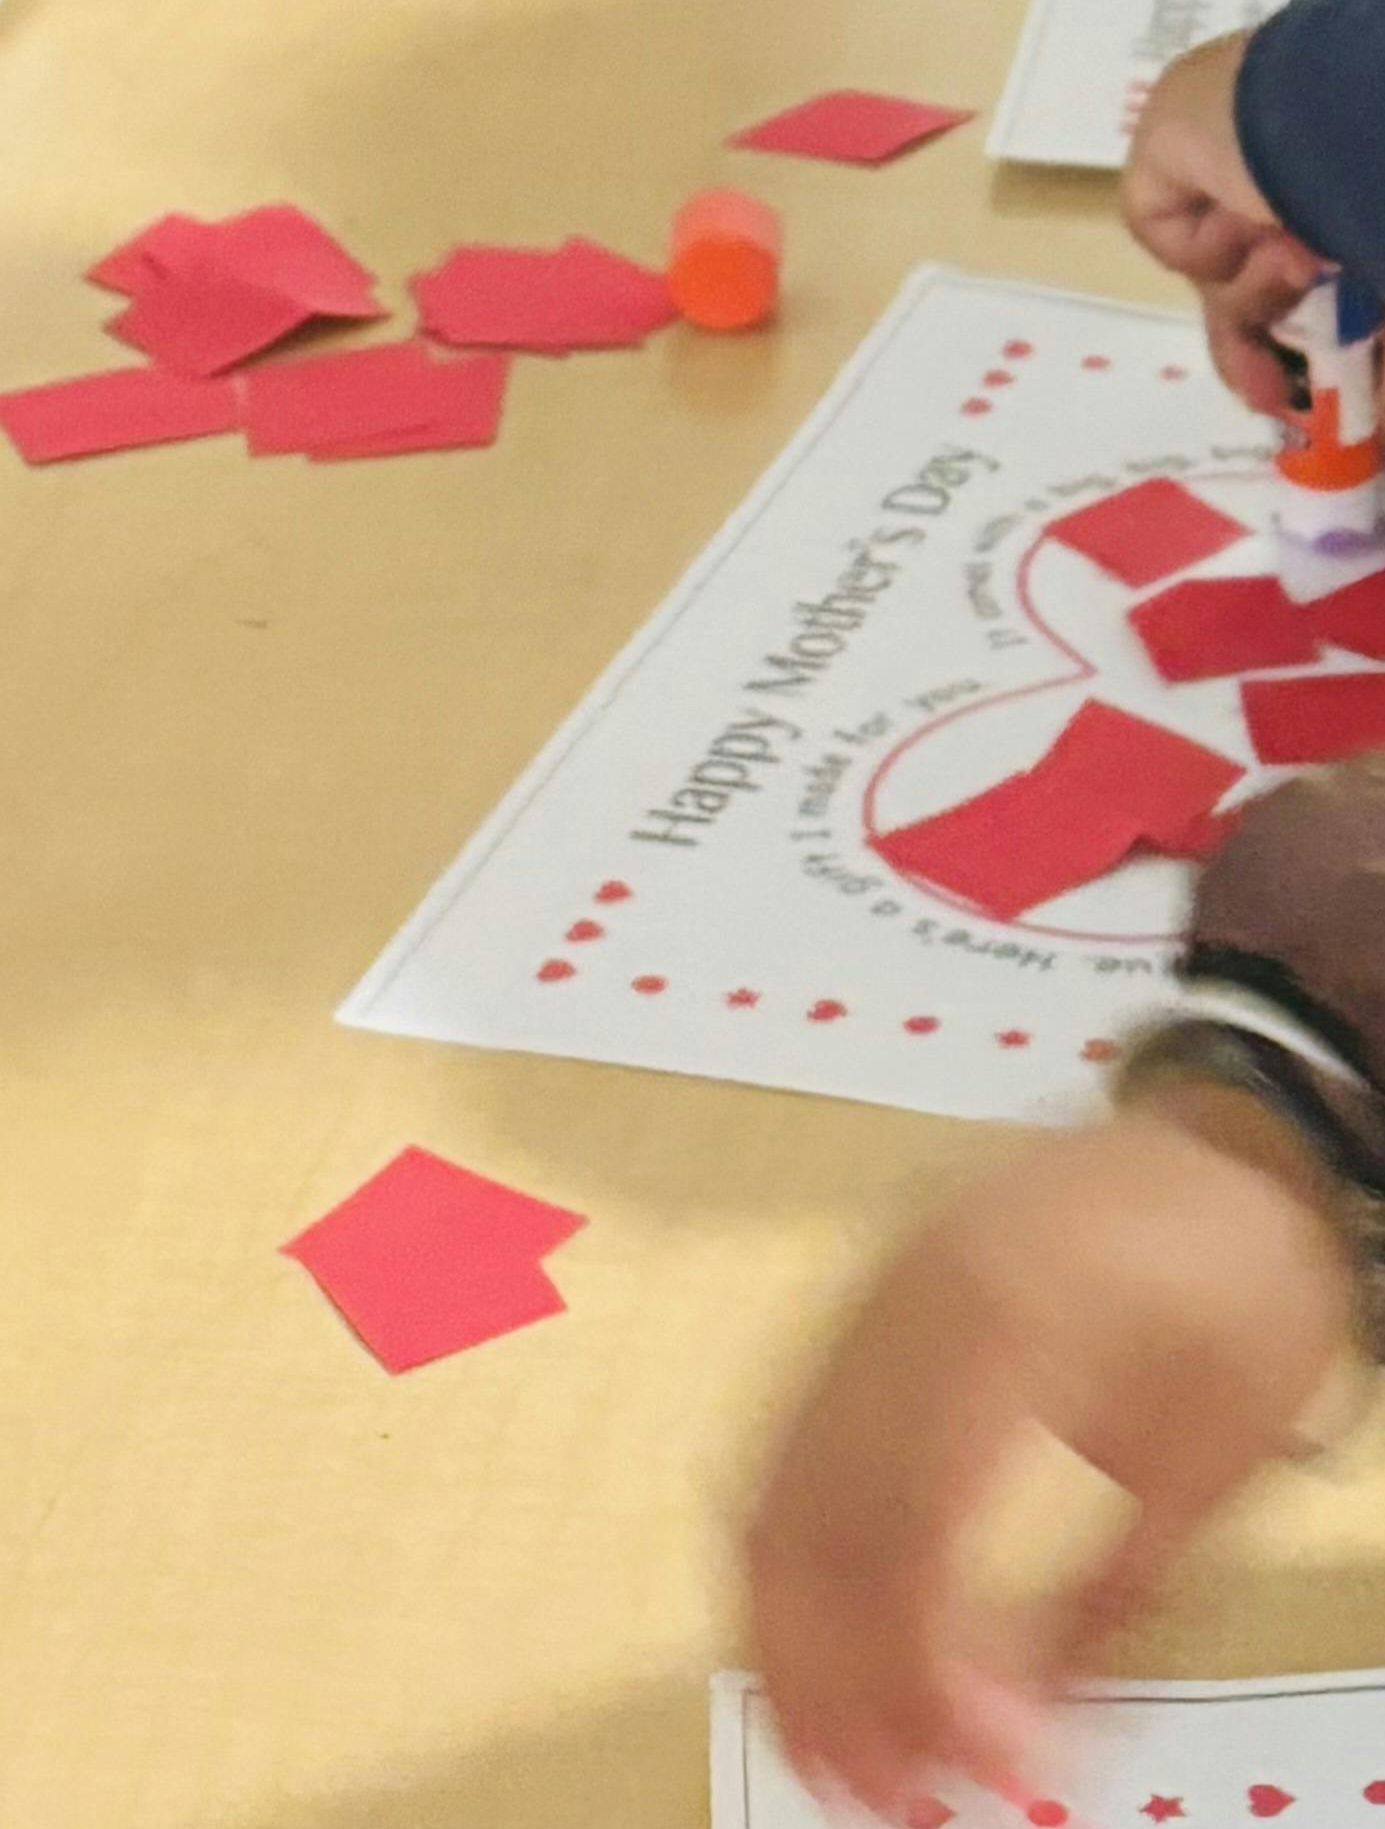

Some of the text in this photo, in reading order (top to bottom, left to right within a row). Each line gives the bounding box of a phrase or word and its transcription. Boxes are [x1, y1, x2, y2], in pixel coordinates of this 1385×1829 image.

[628, 441, 1003, 848] Happy Mother's Day
